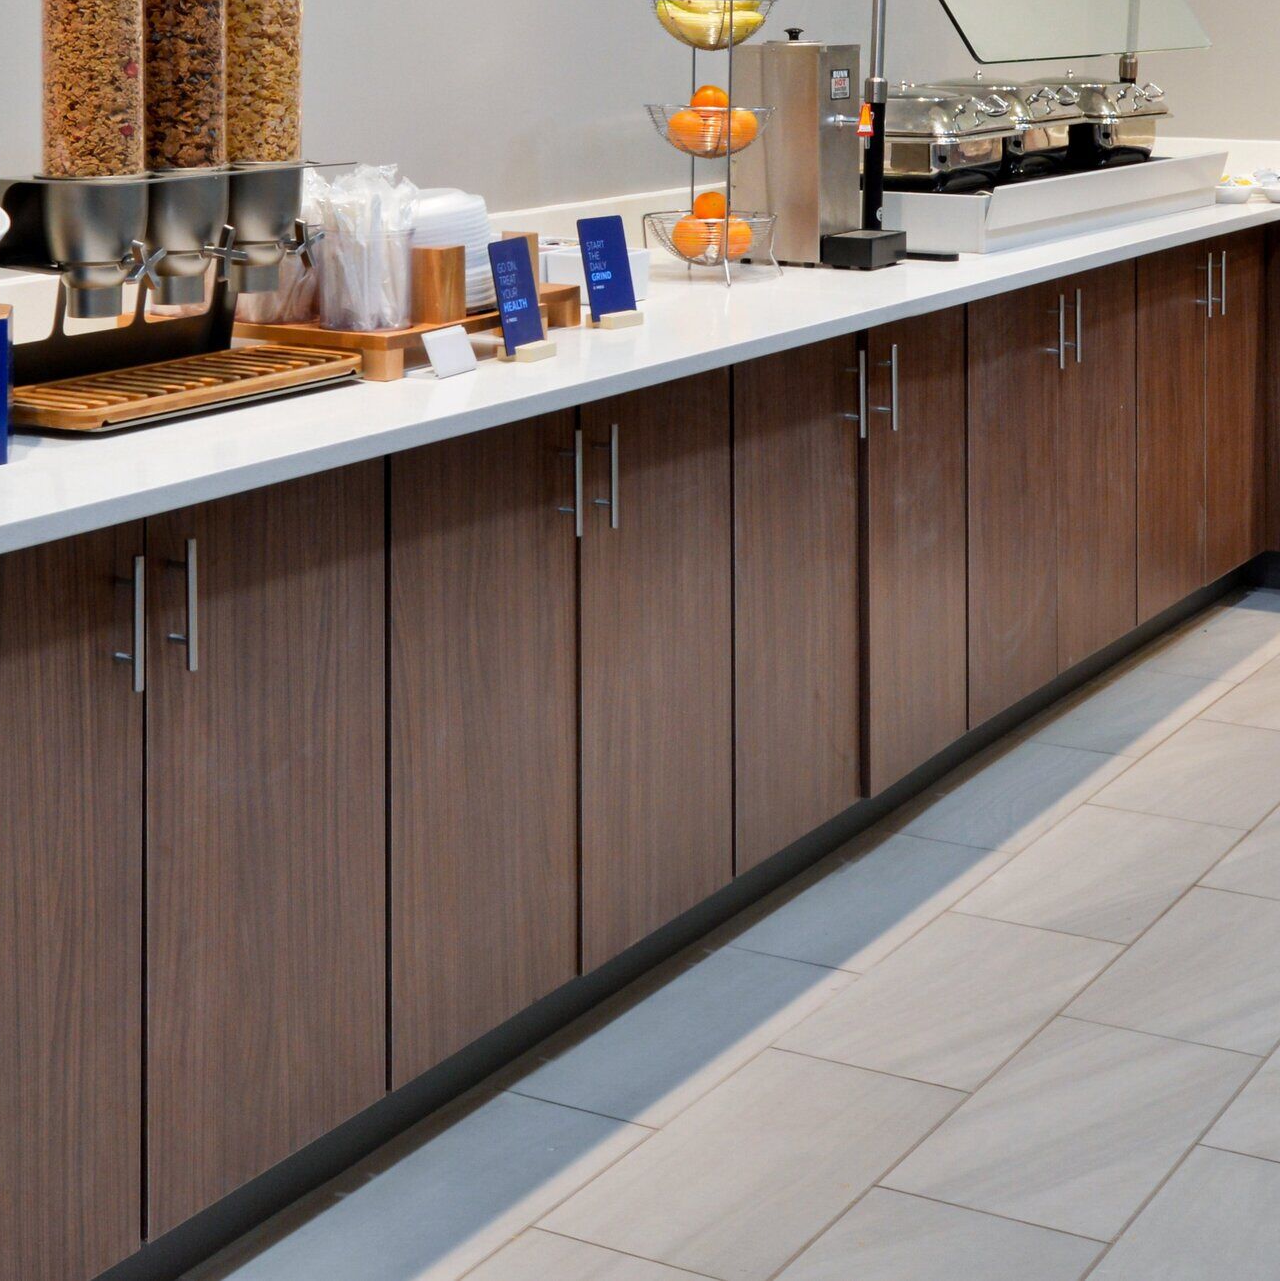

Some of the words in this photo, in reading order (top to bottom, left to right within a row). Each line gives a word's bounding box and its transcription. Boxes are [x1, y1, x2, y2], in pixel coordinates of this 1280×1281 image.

[835, 79, 846, 87] HOT
[586, 240, 605, 249] START
[588, 251, 601, 260] THE
[497, 262, 507, 273] GO
[590, 261, 607, 271] DAILY
[499, 274, 517, 286] TREAT
[591, 271, 612, 281] GRIND
[501, 287, 518, 299] YOUR
[503, 298, 528, 313] HEALTH
